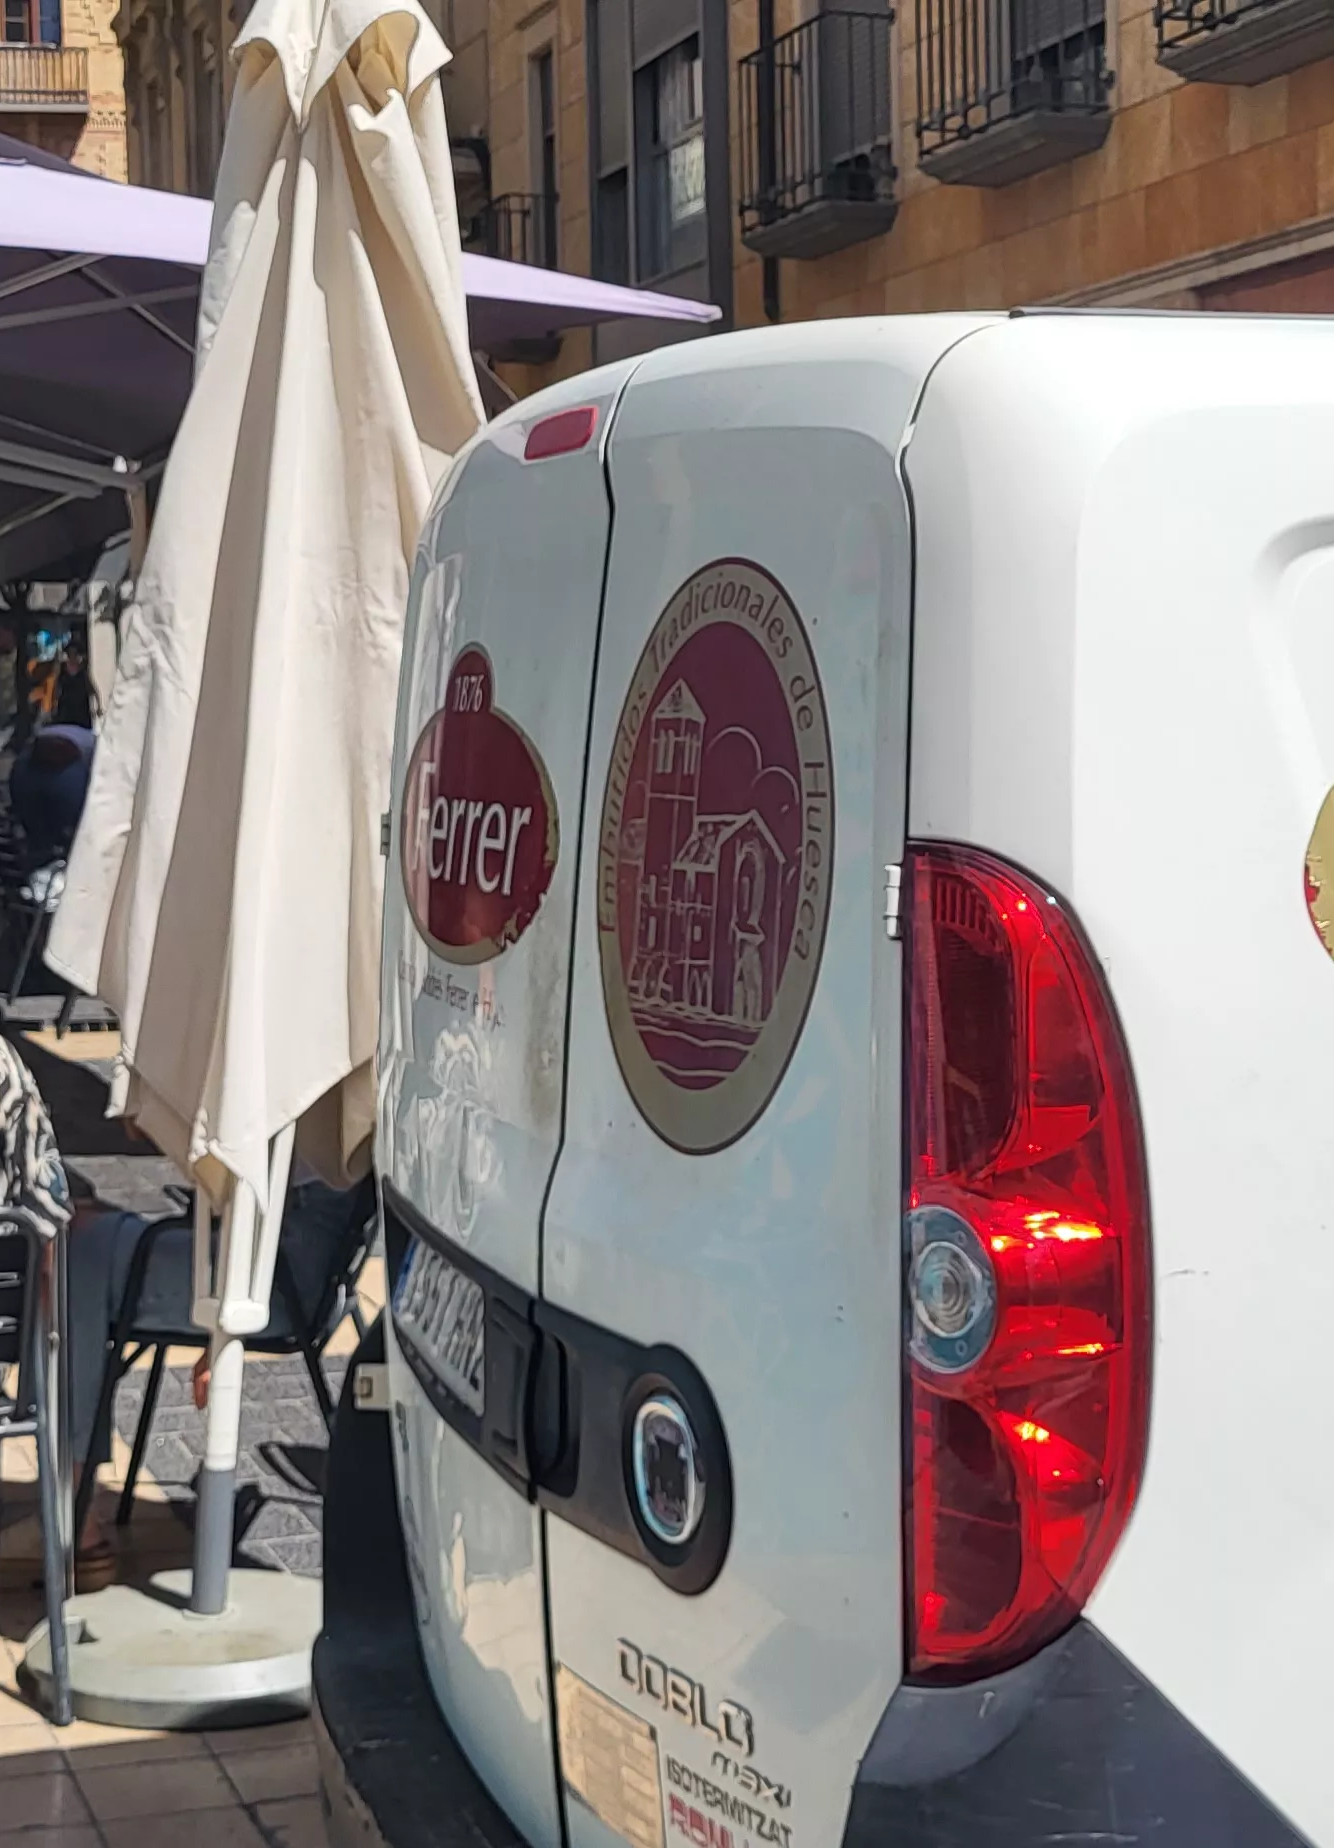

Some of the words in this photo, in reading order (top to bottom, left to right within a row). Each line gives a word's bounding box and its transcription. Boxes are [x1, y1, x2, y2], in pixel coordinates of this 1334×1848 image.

[648, 572, 794, 673] Tradicionales
[452, 673, 486, 713] 1876
[788, 674, 816, 733] de
[412, 761, 532, 896] Ferrer
[794, 760, 828, 961] Huesca
